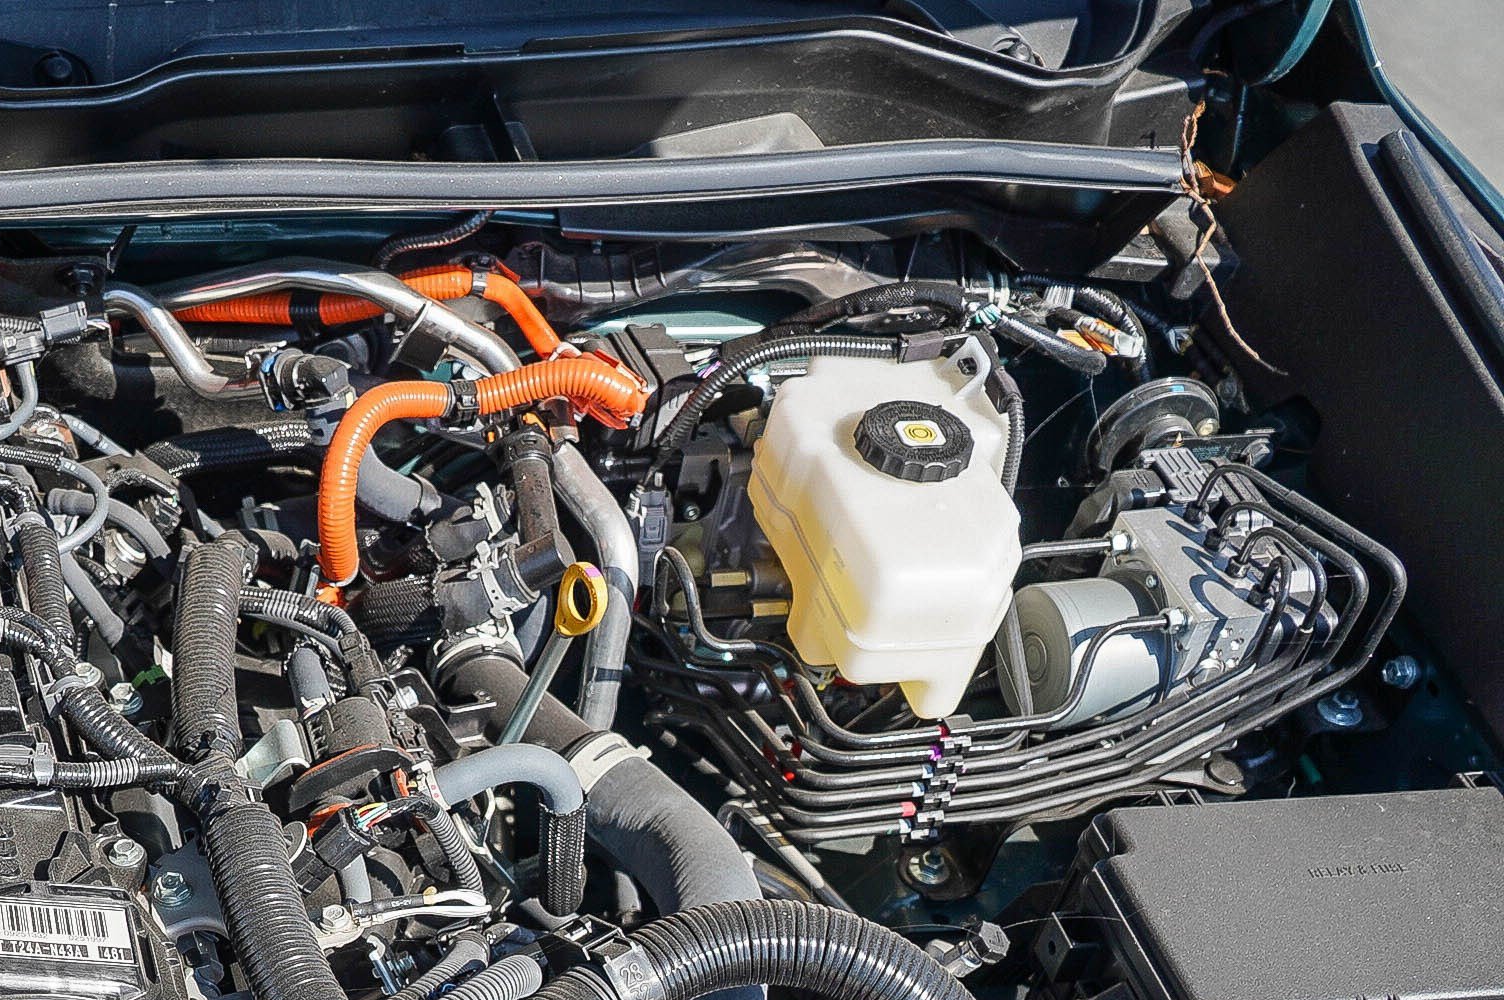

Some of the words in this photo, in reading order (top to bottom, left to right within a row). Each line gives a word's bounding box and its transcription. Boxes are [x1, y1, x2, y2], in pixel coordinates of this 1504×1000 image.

[1307, 863, 1354, 879] RELAY
[1356, 863, 1367, 874] &
[1370, 862, 1409, 874] FUSE
[10, 940, 84, 958] T24A-N43A
[619, 962, 644, 989] 28
